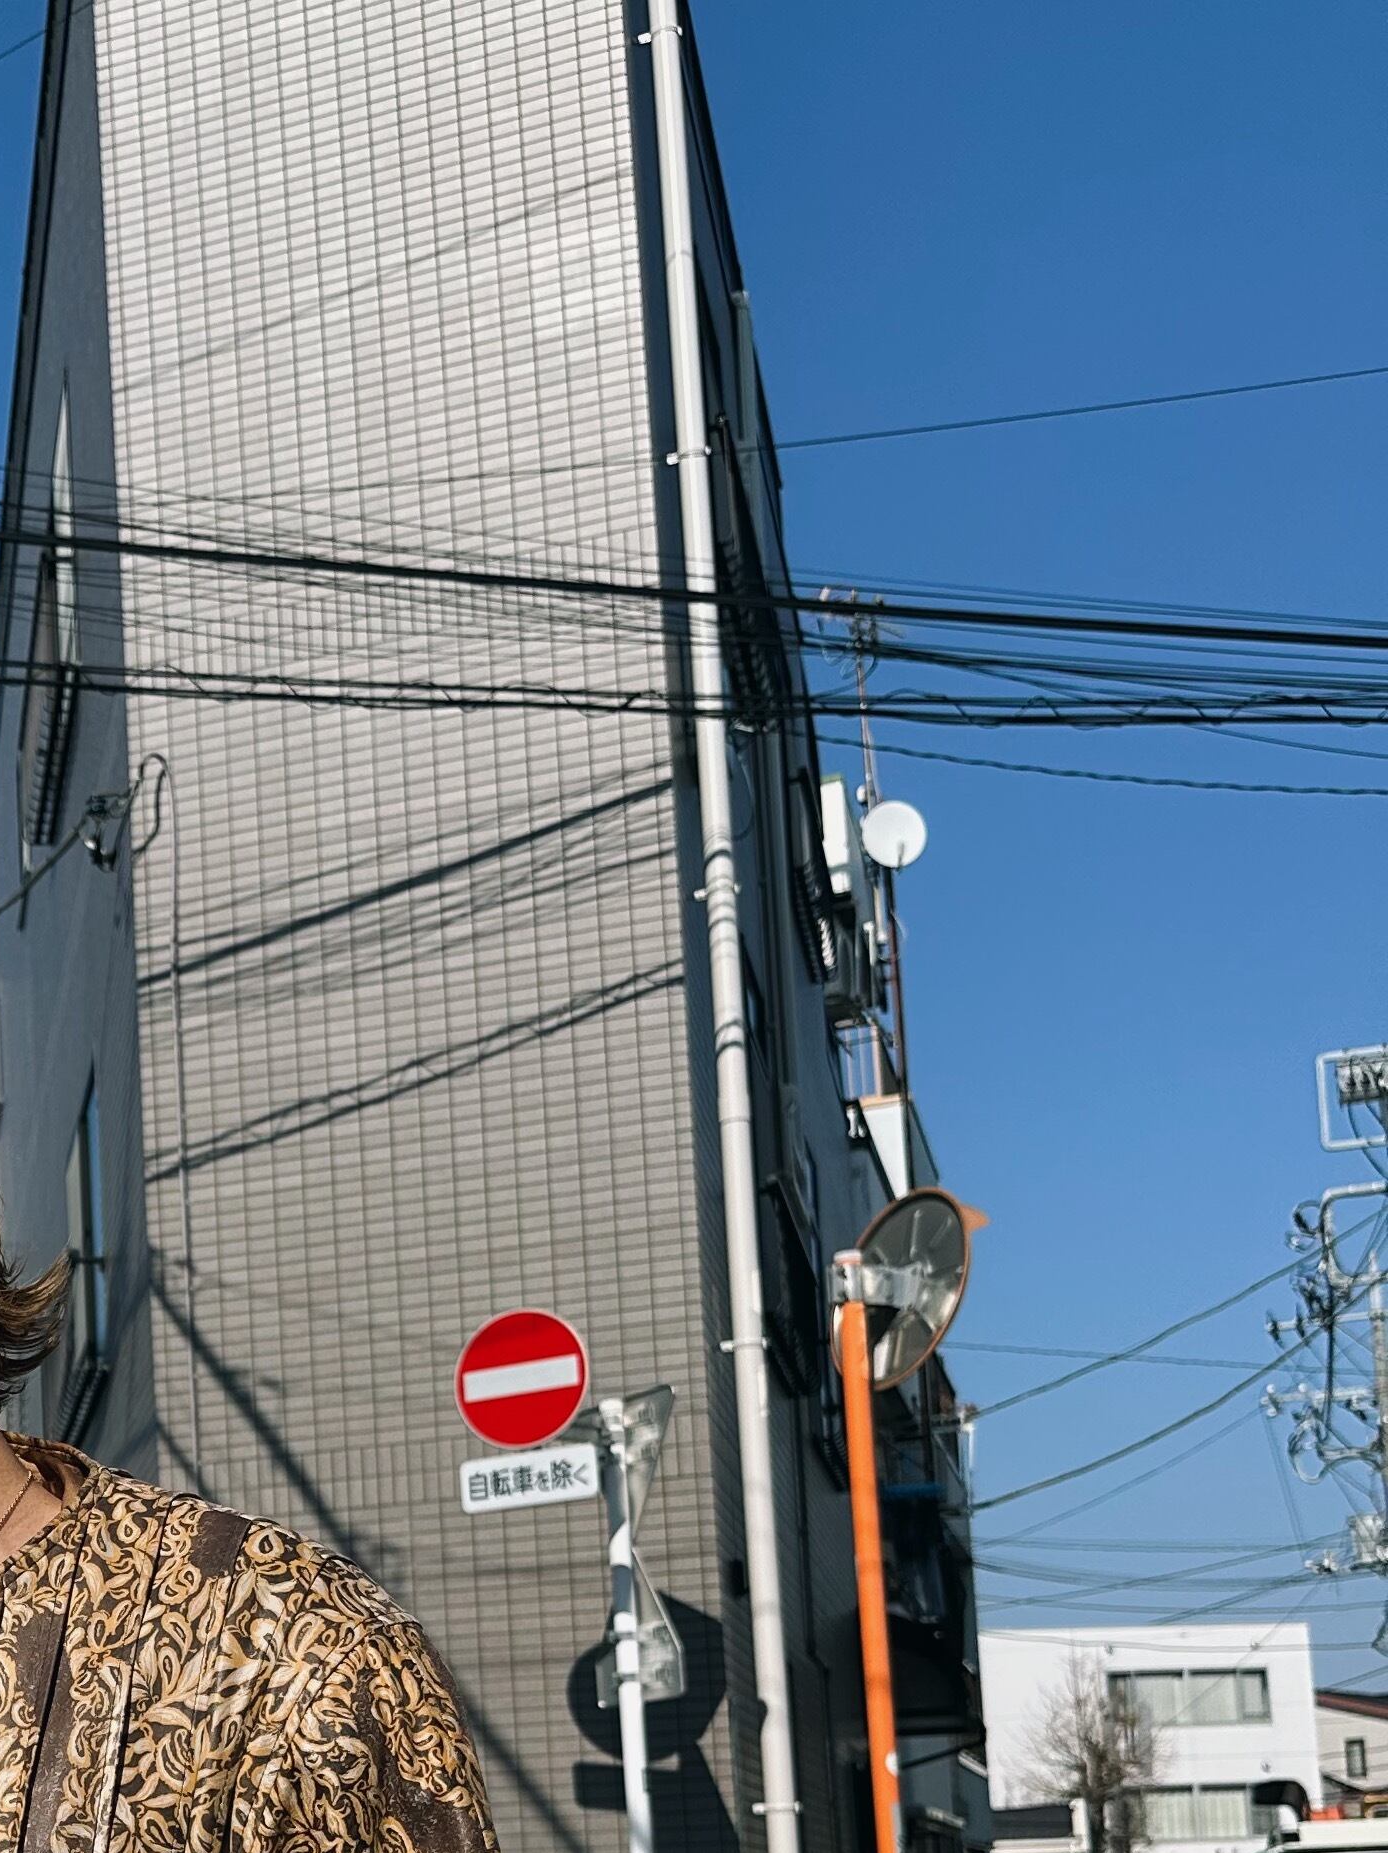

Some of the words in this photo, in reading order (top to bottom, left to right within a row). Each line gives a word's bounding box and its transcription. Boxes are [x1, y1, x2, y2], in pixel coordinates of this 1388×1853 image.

[468, 1459, 589, 1501] 自転車を除く
